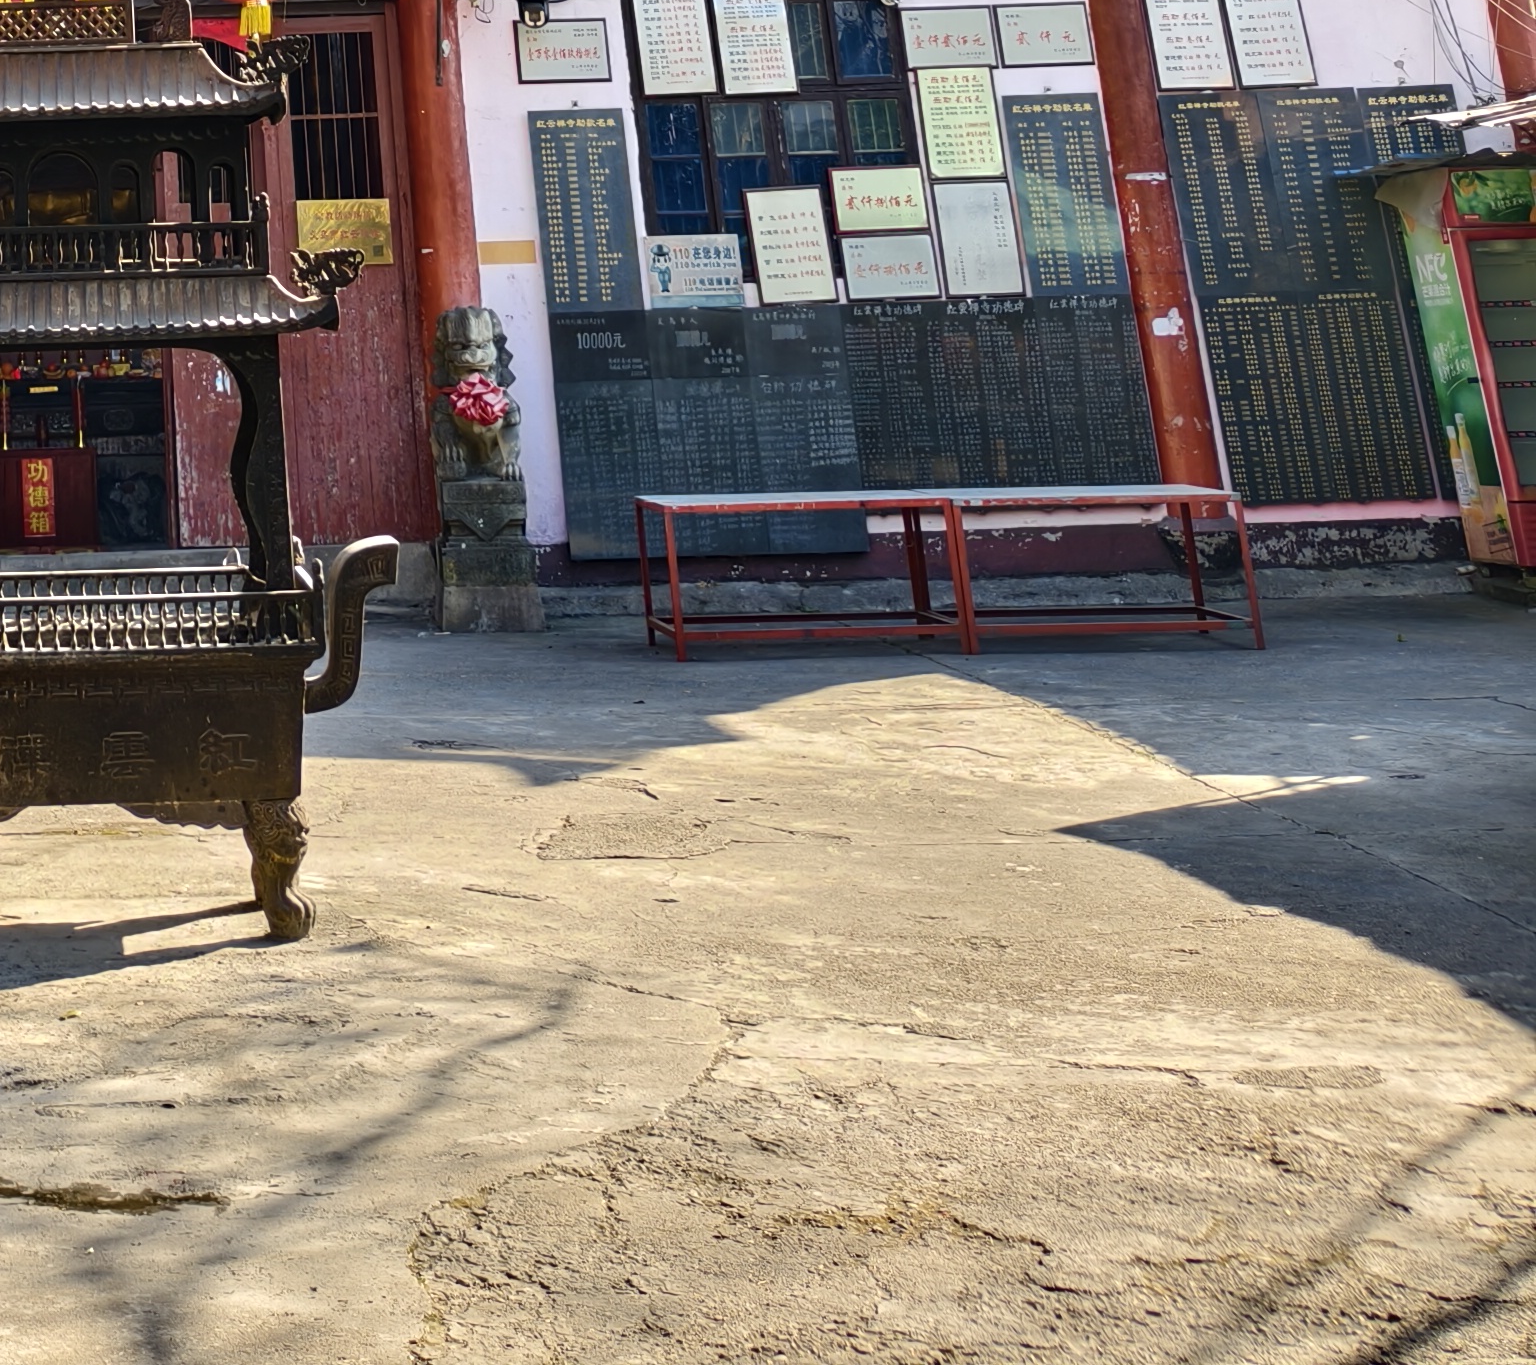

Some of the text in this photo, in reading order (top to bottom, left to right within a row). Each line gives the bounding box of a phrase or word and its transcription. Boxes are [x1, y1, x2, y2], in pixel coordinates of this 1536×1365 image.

[673, 248, 690, 260] 110
[674, 261, 690, 269] 110
[691, 261, 701, 269] be
[702, 260, 721, 268] with
[1415, 252, 1448, 283] NFC
[684, 277, 697, 286] 110
[576, 331, 626, 350] 10000元
[27, 459, 51, 533] 功德箱
